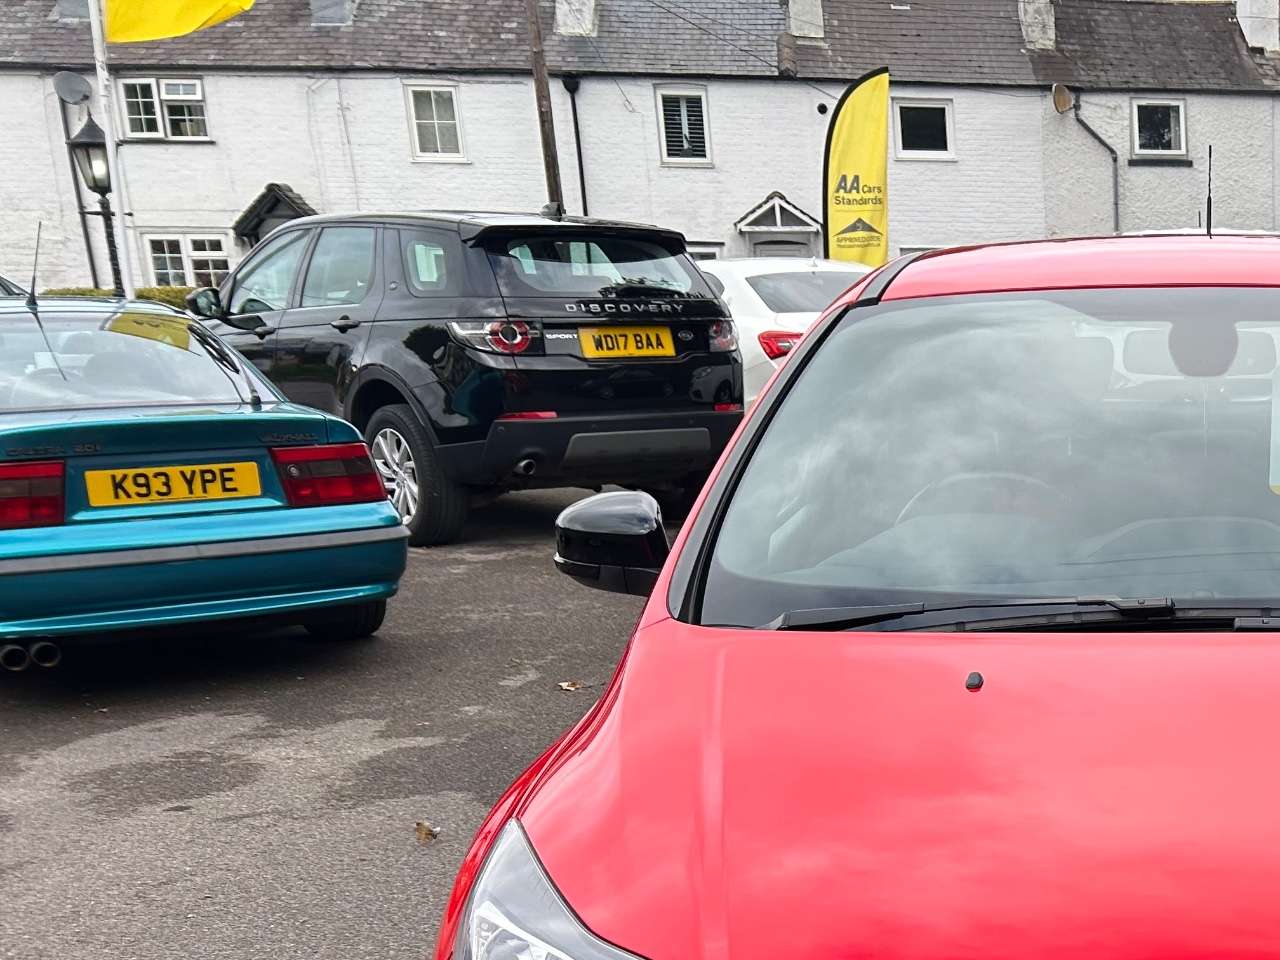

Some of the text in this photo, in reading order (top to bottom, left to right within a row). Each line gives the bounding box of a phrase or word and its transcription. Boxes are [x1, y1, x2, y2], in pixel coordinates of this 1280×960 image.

[834, 174, 882, 194] AA Cars
[834, 195, 883, 206] Standards
[565, 303, 685, 313] DISCOVERY
[592, 333, 630, 351] WD17
[633, 333, 665, 350] BAA
[110, 467, 238, 499] K93 YPE
